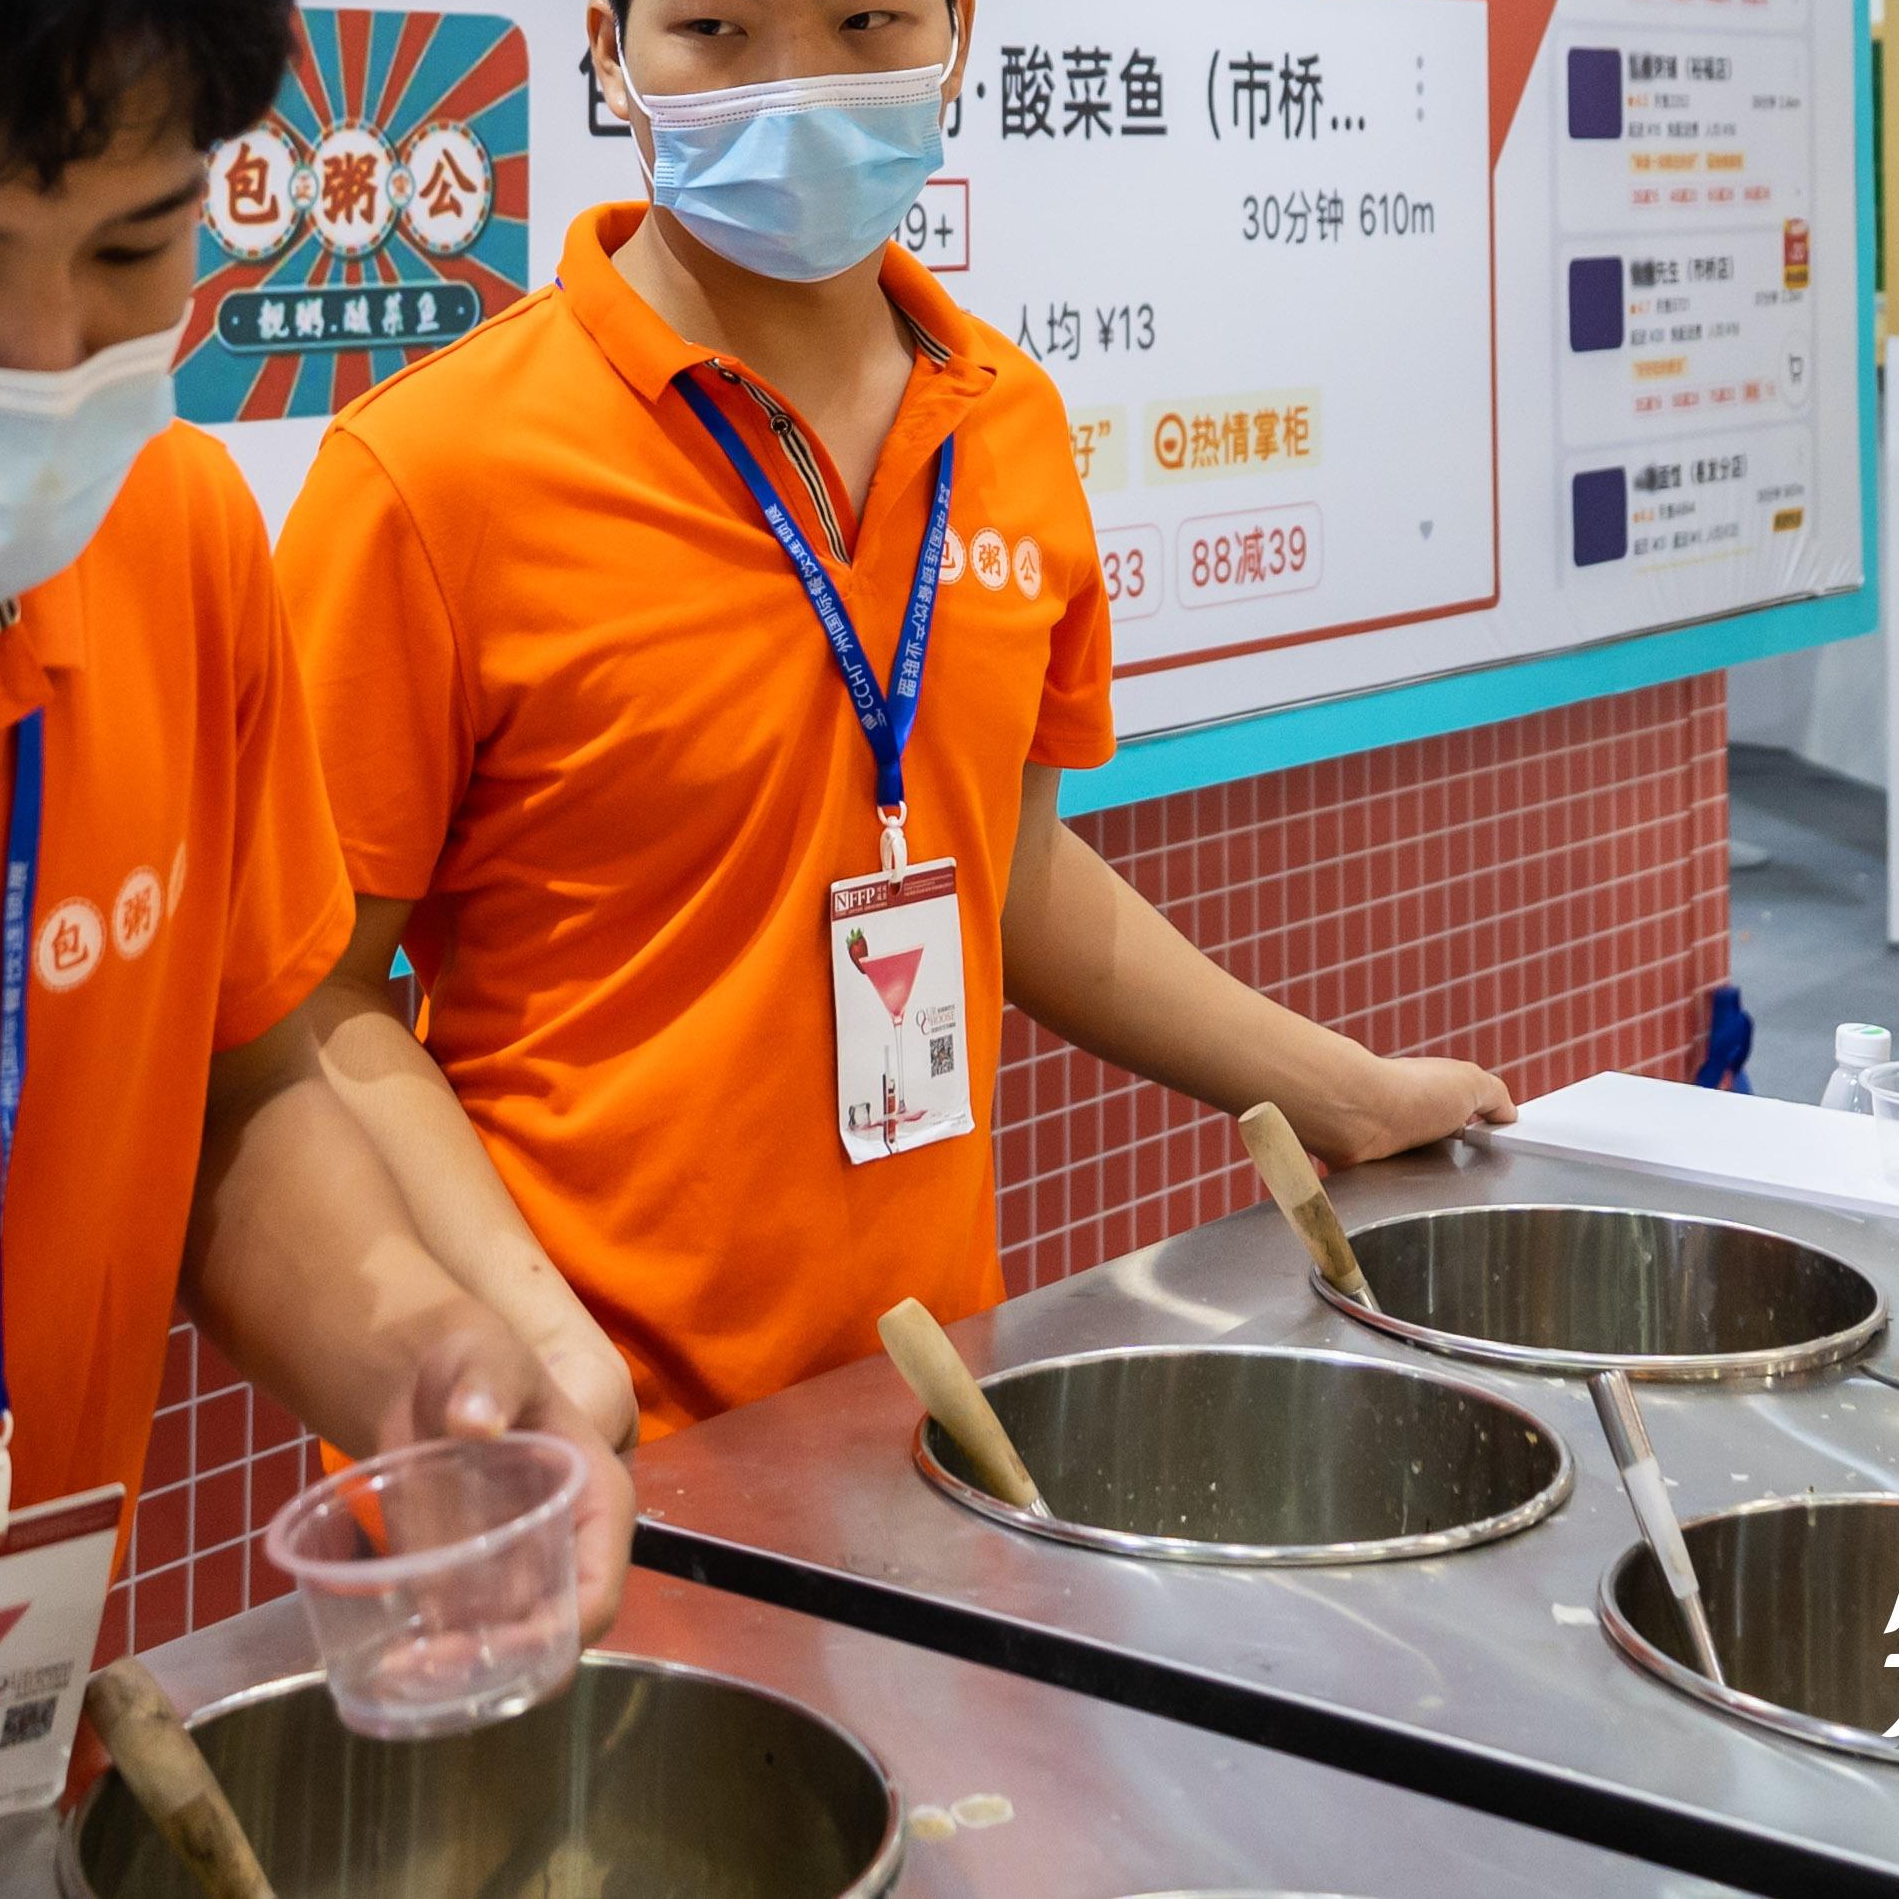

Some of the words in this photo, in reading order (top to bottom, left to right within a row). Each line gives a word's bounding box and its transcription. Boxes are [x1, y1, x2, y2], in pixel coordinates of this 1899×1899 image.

[224, 142, 478, 226] 包粥公
[1241, 188, 1344, 245] 30分钟
[1359, 194, 1435, 236] 610m
[1016, 303, 1081, 362] 人均
[1098, 302, 1156, 348] ¥13
[1190, 403, 1310, 469] 热情掌柜
[1192, 525, 1308, 589] 88减39
[834, 886, 876, 913] NFFP
